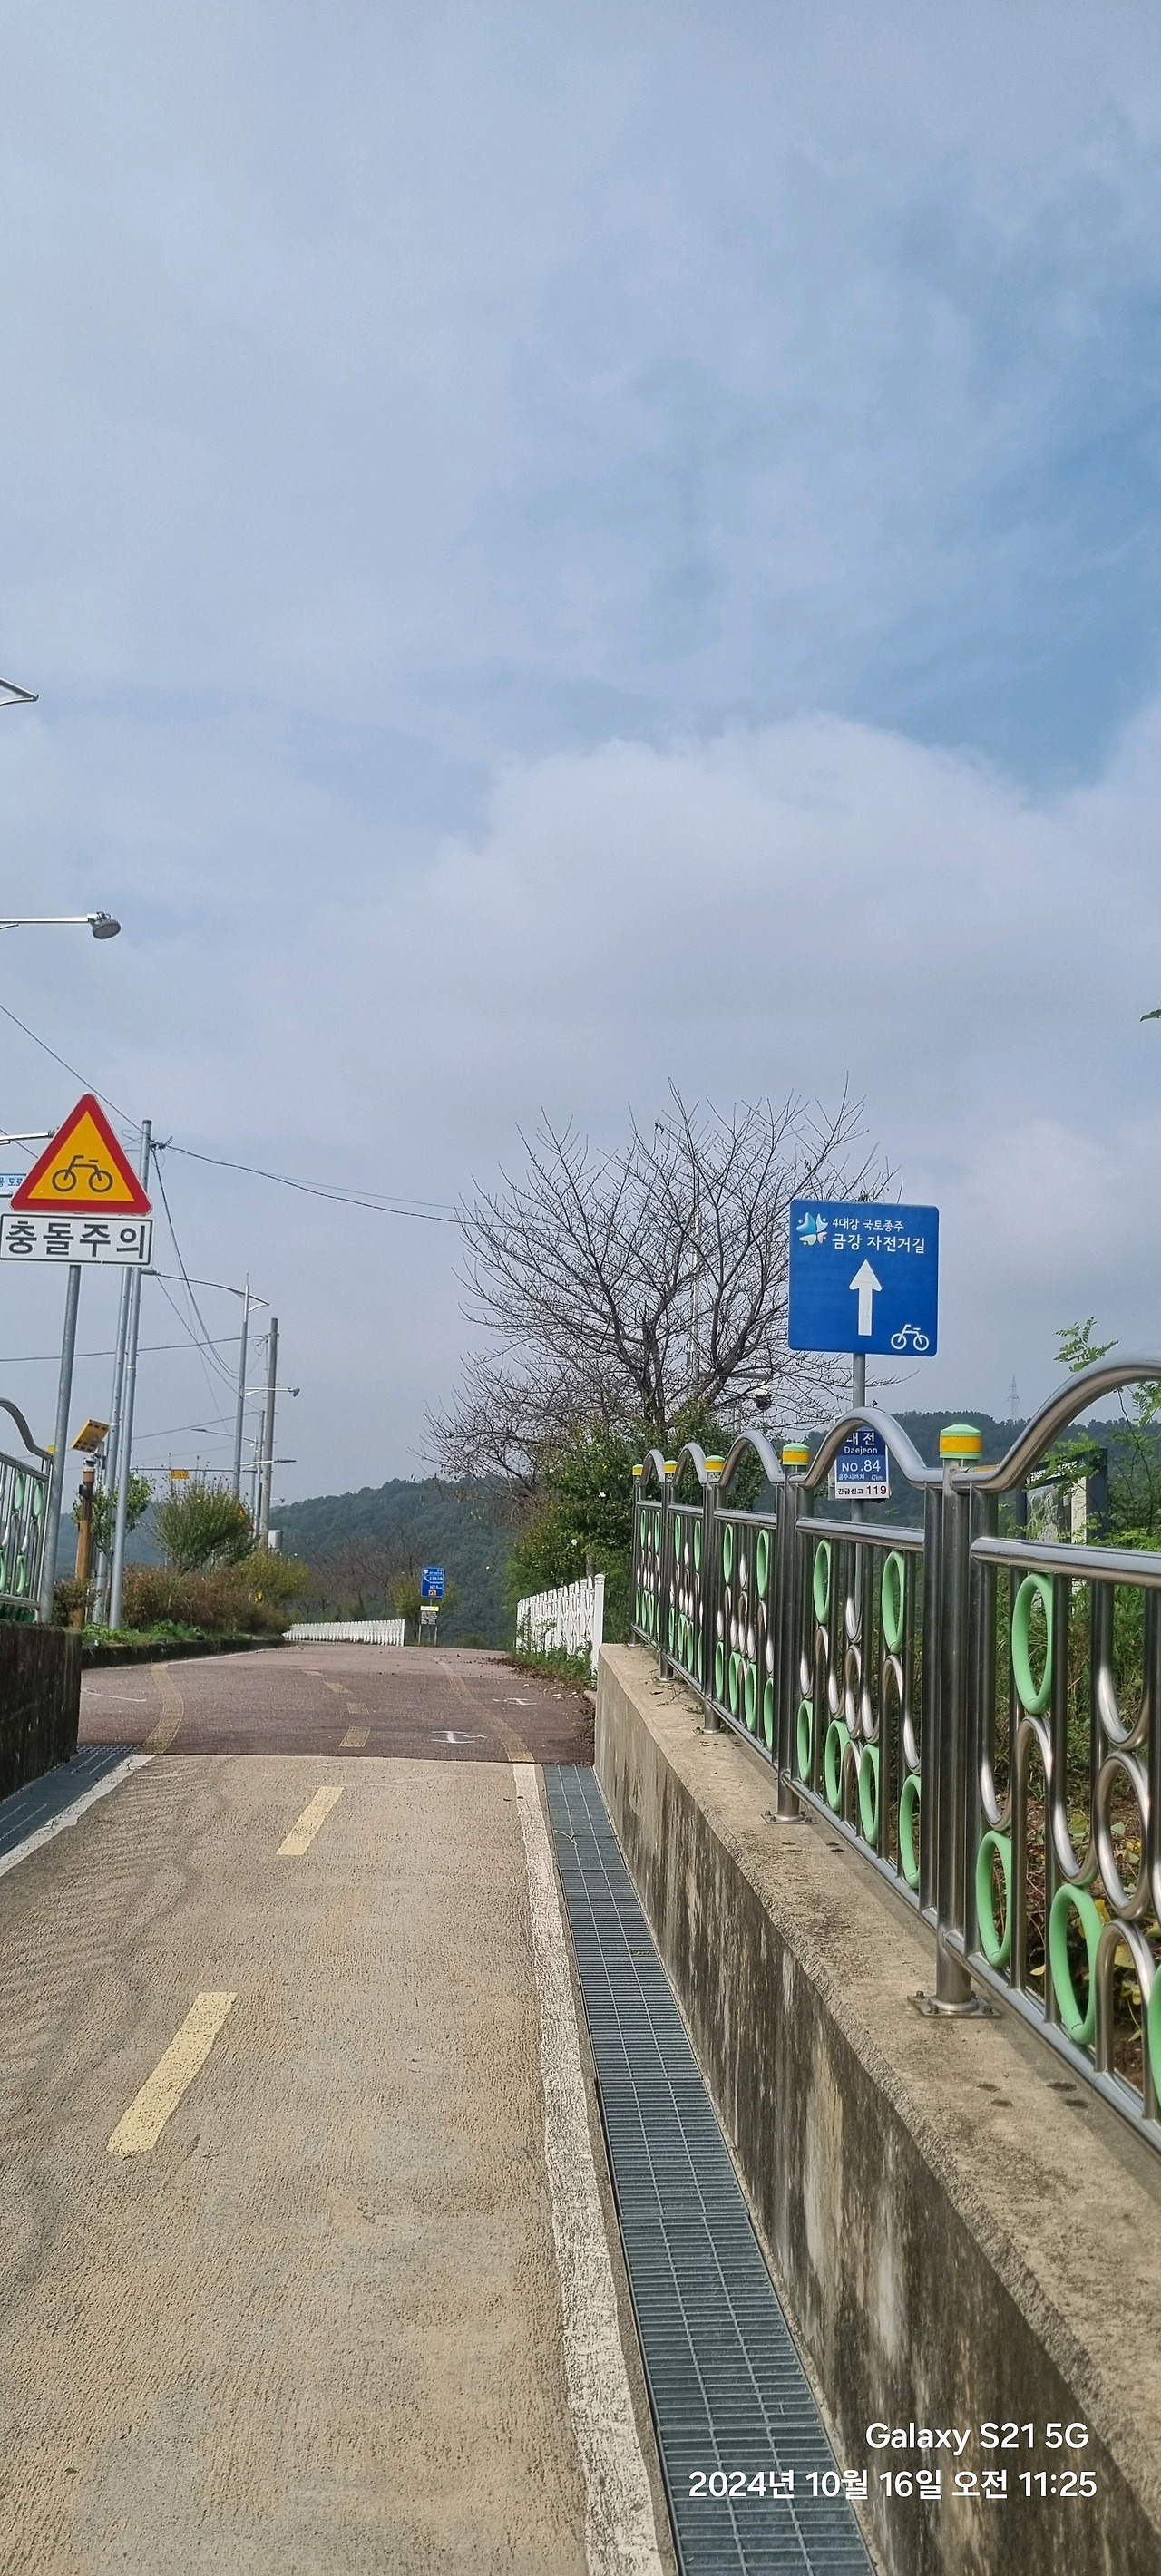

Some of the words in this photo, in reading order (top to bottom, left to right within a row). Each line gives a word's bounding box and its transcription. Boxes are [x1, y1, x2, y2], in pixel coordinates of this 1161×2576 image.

[832, 1218, 860, 1230] 4대강
[863, 1219, 904, 1232] 국토종주
[5, 1220, 146, 1259] 충돌주의
[832, 1233, 863, 1250] 금강
[867, 1235, 925, 1254] 자전거길
[844, 1445, 878, 1455] Daejeon
[837, 1487, 864, 1495] 긴급신고
[866, 1485, 887, 1495] 119
